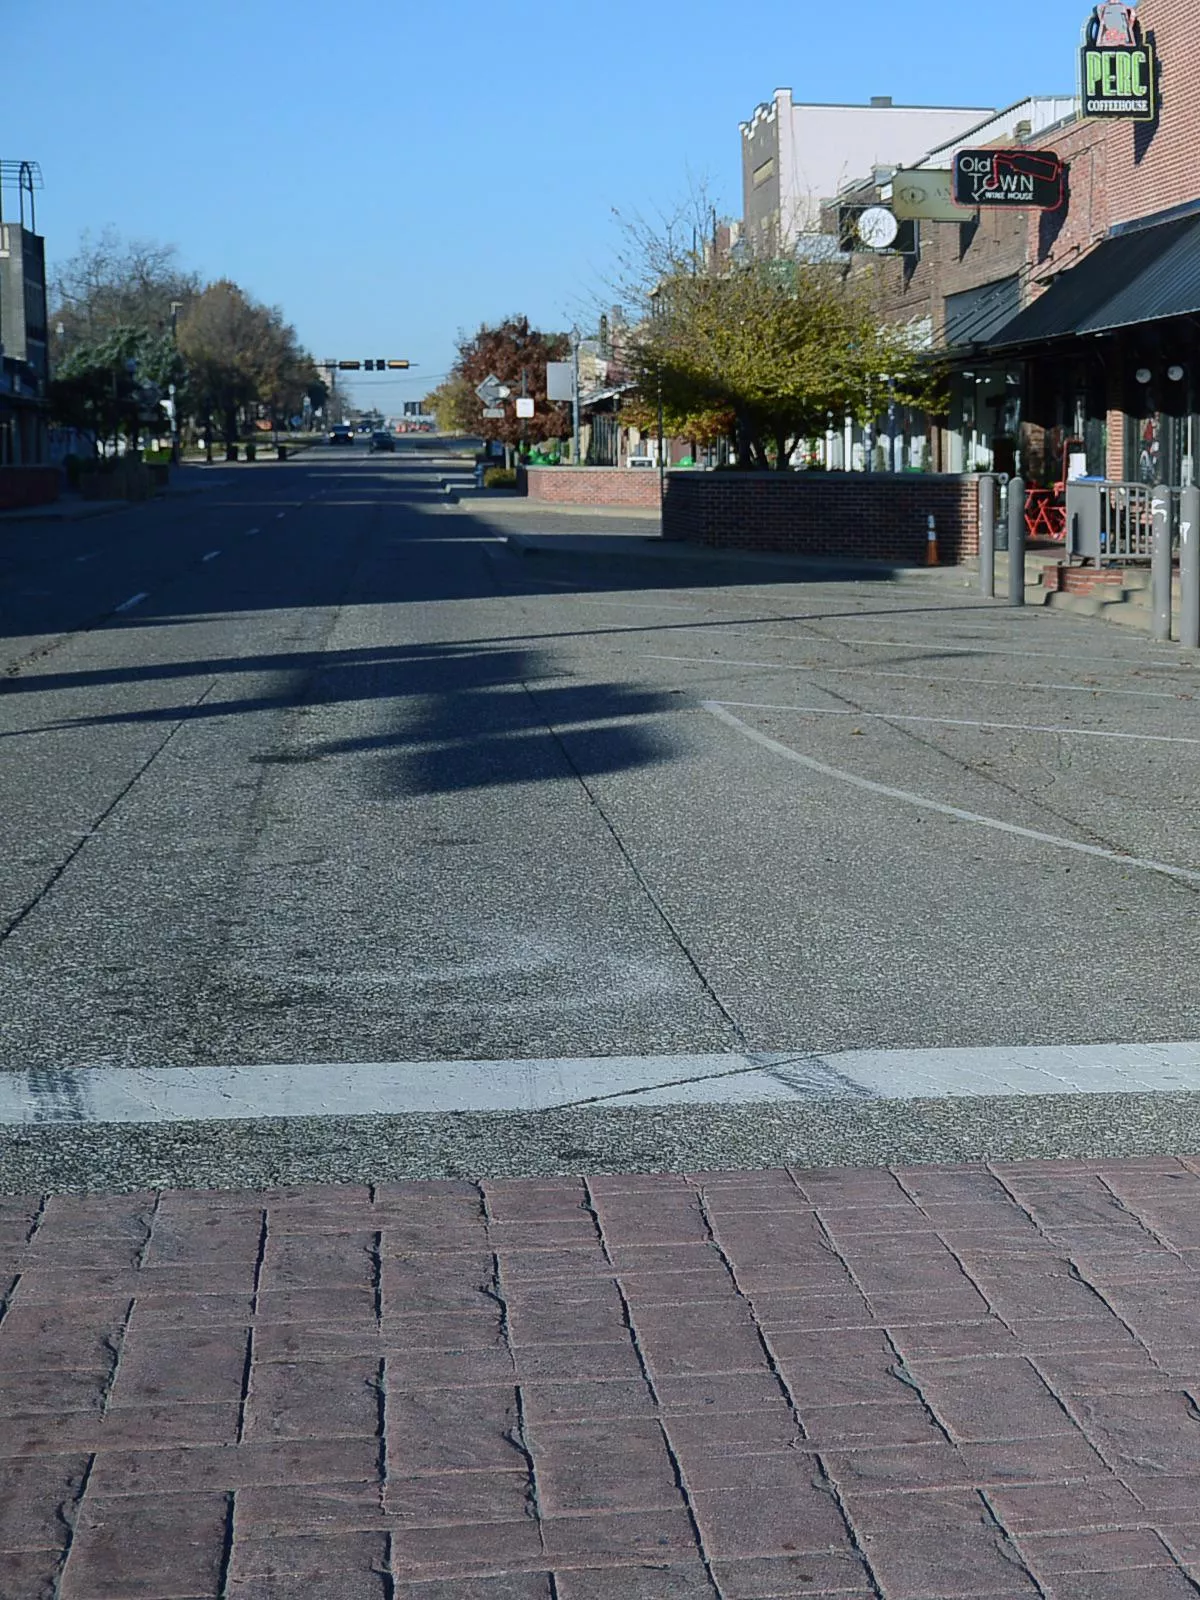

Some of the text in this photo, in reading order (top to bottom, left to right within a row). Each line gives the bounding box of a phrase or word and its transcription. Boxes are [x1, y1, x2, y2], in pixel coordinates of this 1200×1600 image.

[1086, 51, 1147, 96] PERC
[1087, 100, 1148, 111] COFFEEHOUSE
[960, 157, 991, 172] Old
[968, 173, 1033, 194] TOWN
[985, 191, 1033, 200] WINE HOUSE
